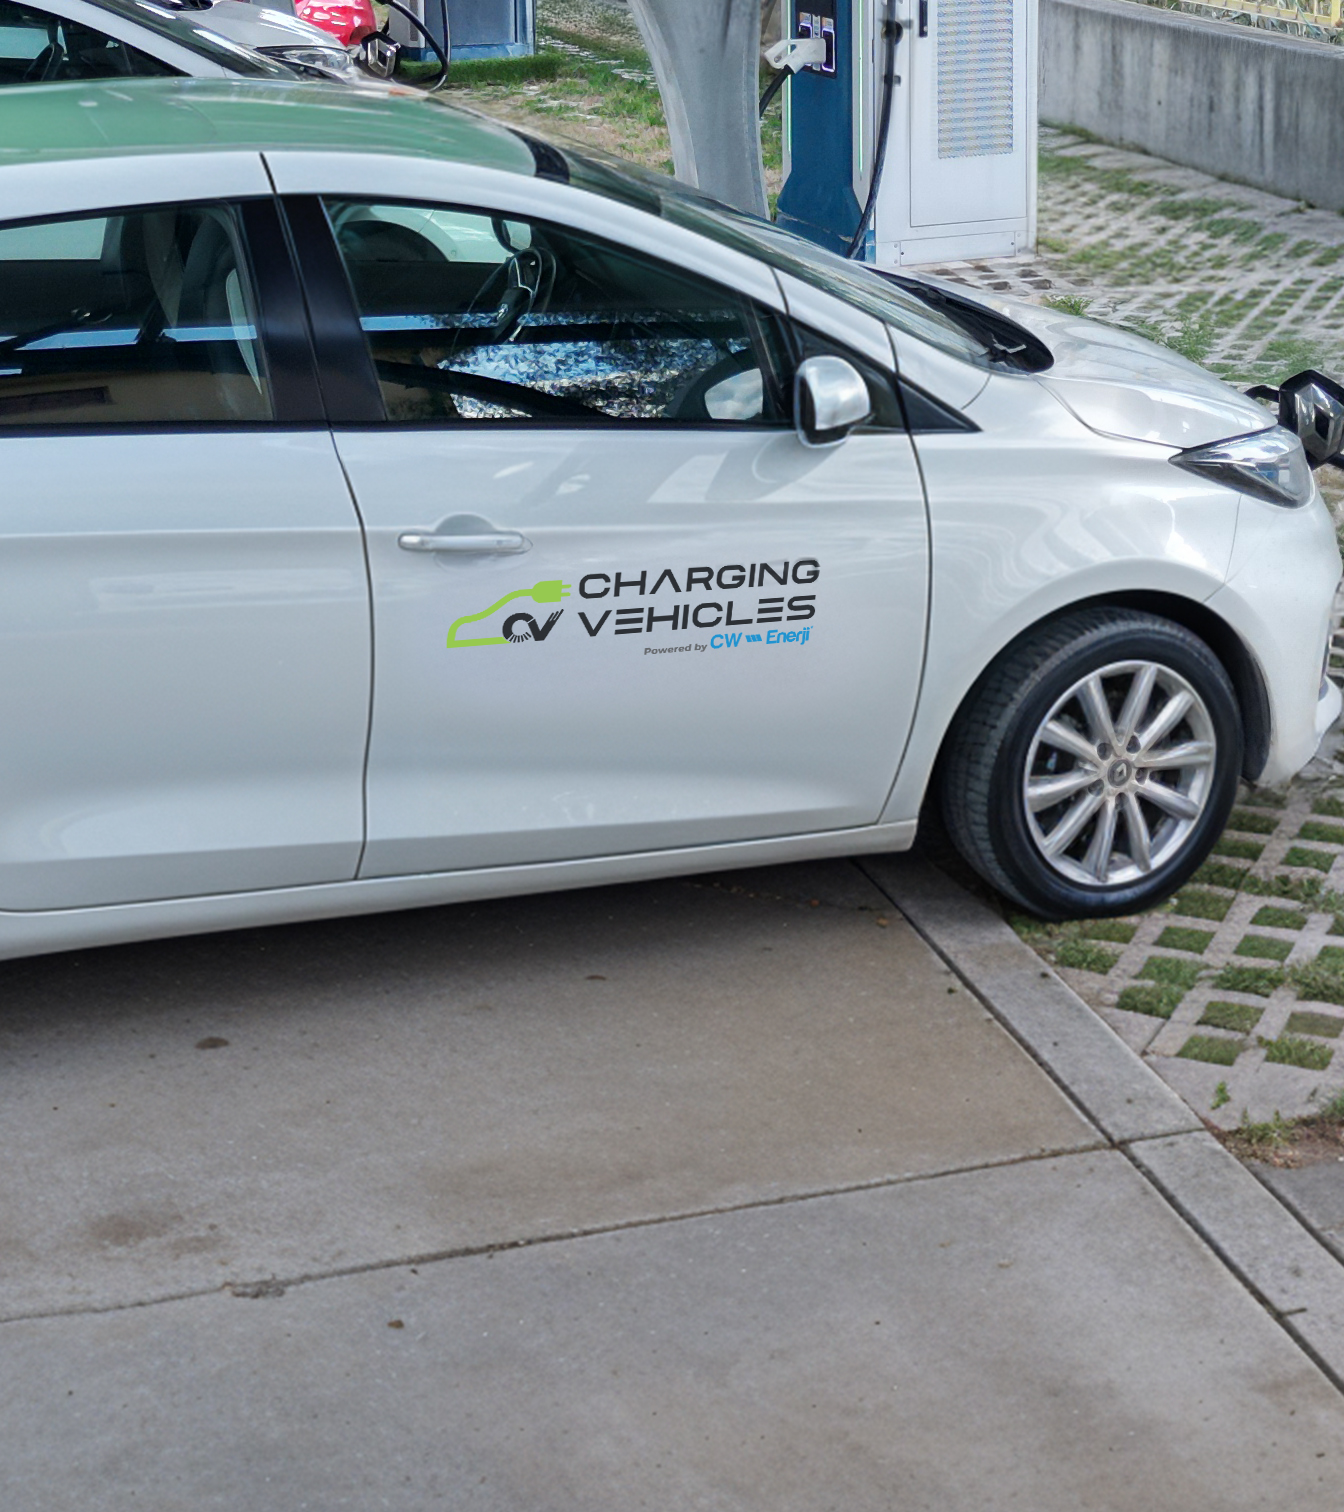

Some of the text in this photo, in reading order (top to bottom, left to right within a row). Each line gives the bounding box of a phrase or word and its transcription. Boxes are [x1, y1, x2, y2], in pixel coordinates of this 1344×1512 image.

[578, 559, 821, 600] CHARGING
[578, 594, 817, 637] VEHICLES
[644, 626, 811, 656] Powered by CW Enerji
